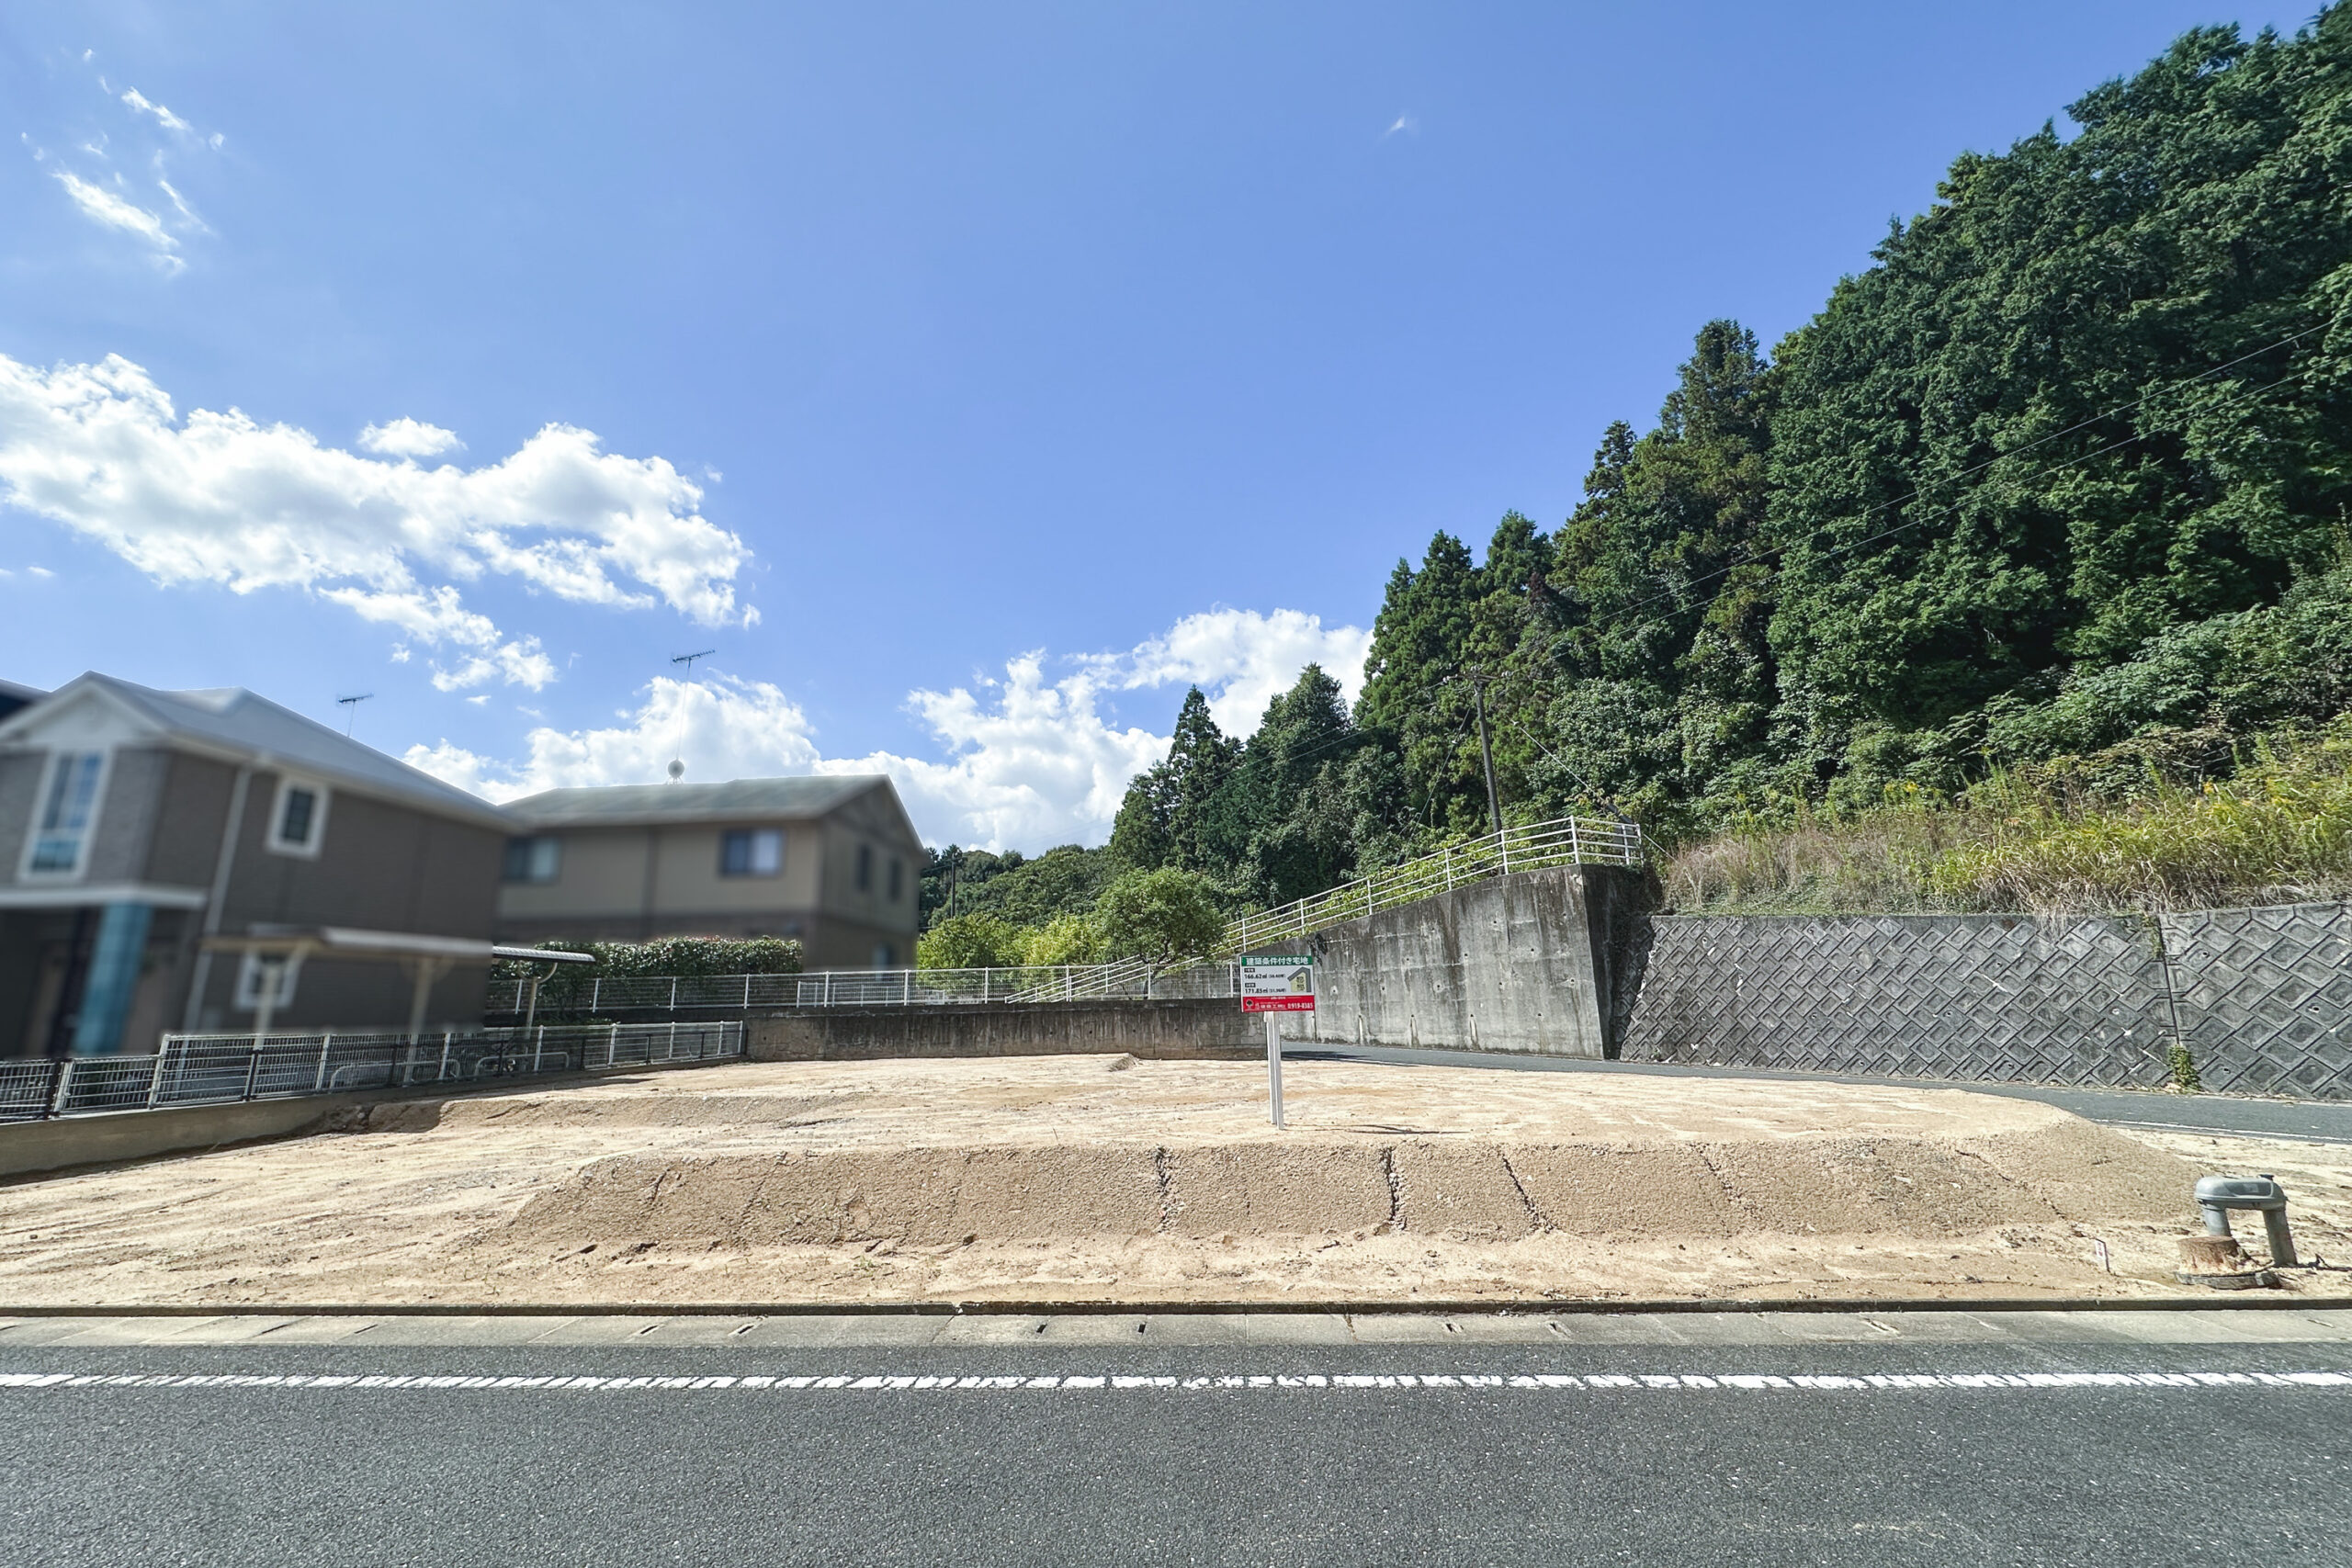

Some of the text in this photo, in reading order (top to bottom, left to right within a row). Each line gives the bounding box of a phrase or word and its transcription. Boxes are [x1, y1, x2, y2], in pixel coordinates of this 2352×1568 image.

[1246, 957, 1309, 965] 建築条件付き宅地
